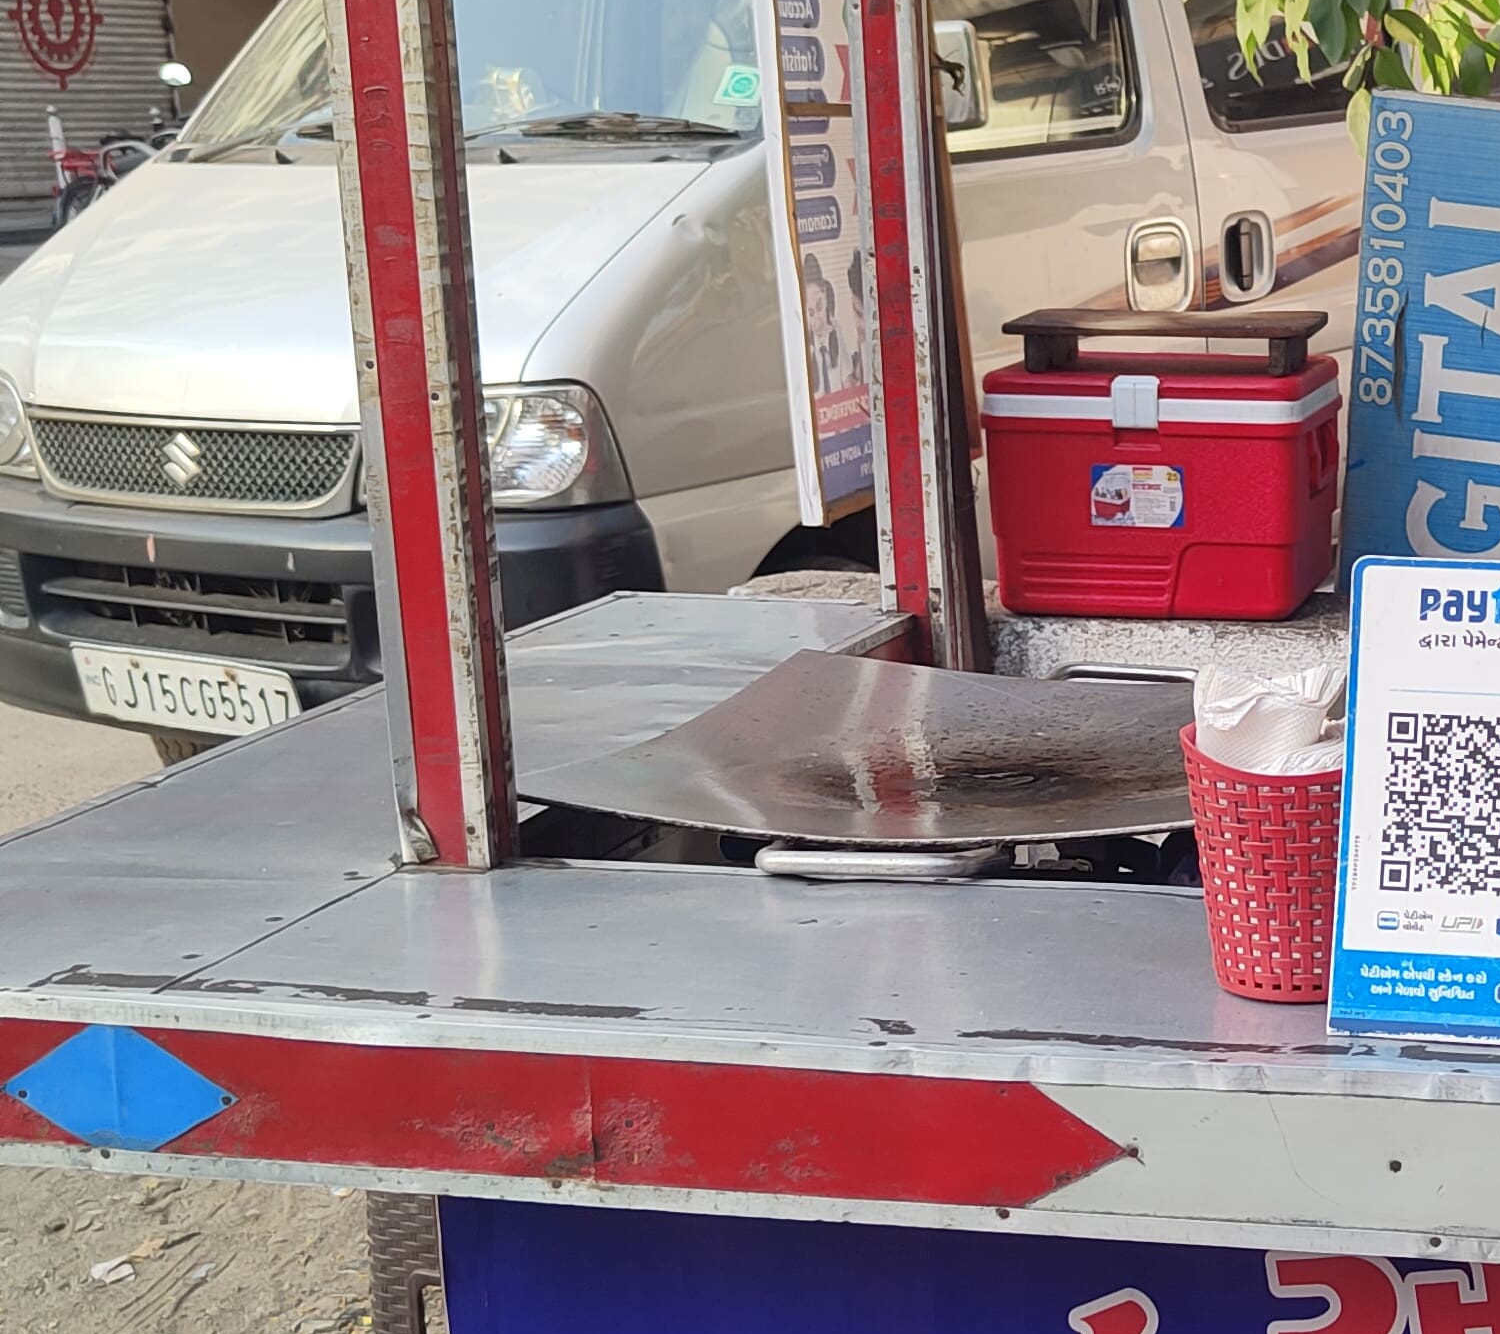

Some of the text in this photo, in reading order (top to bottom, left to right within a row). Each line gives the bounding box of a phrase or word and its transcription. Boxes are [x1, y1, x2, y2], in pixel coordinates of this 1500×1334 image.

[1358, 109, 1414, 407] 8735810403
[102, 666, 289, 726] GJ15CG5517
[1440, 915, 1484, 931] UPI
